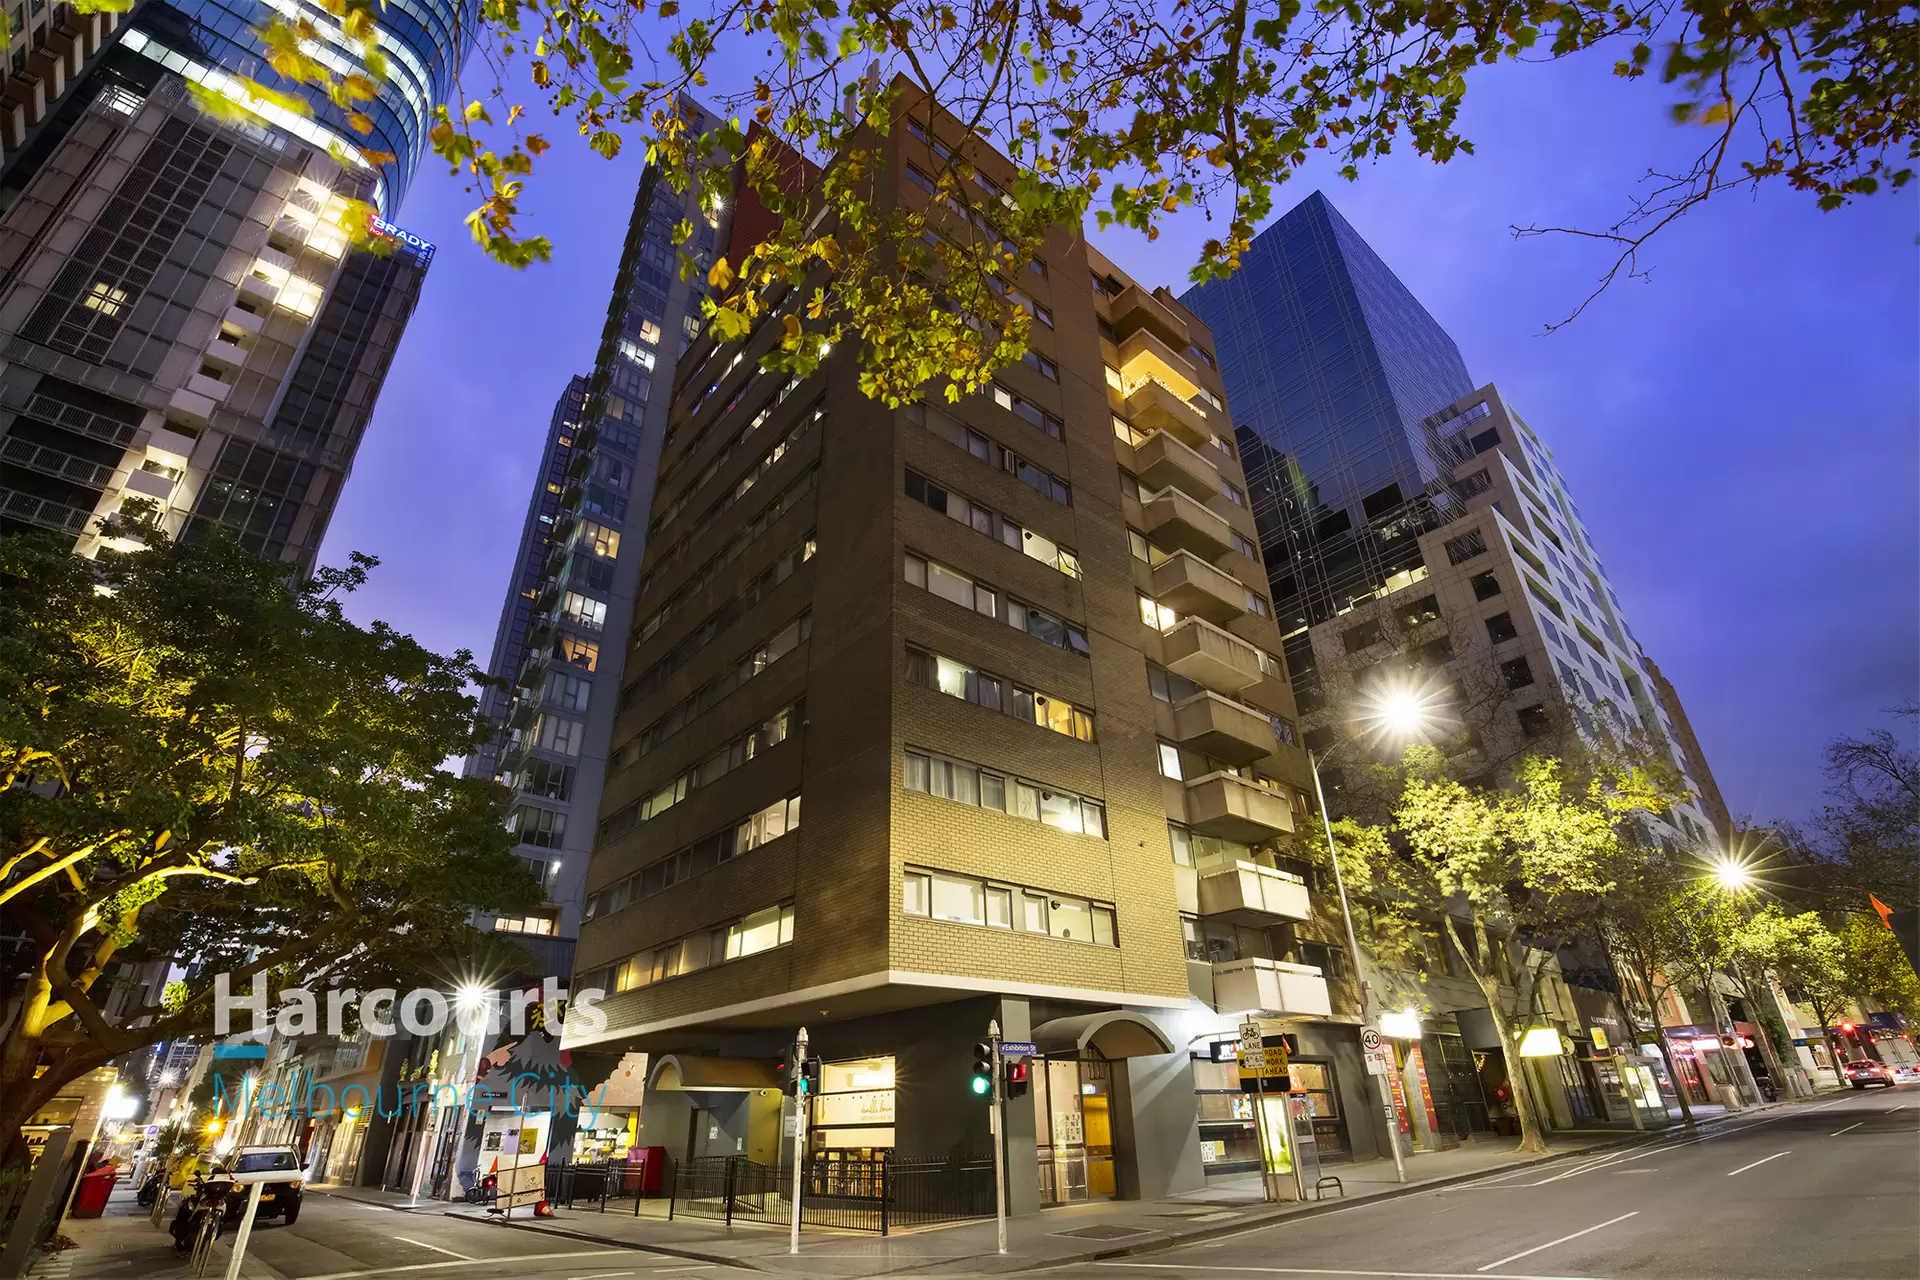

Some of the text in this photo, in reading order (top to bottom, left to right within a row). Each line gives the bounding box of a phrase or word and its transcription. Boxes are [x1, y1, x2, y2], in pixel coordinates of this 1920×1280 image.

[373, 217, 430, 250] BRADY
[1364, 1034, 1379, 1045] 40
[1244, 1042, 1261, 1050] LANE
[1265, 1067, 1288, 1075] AHEAD
